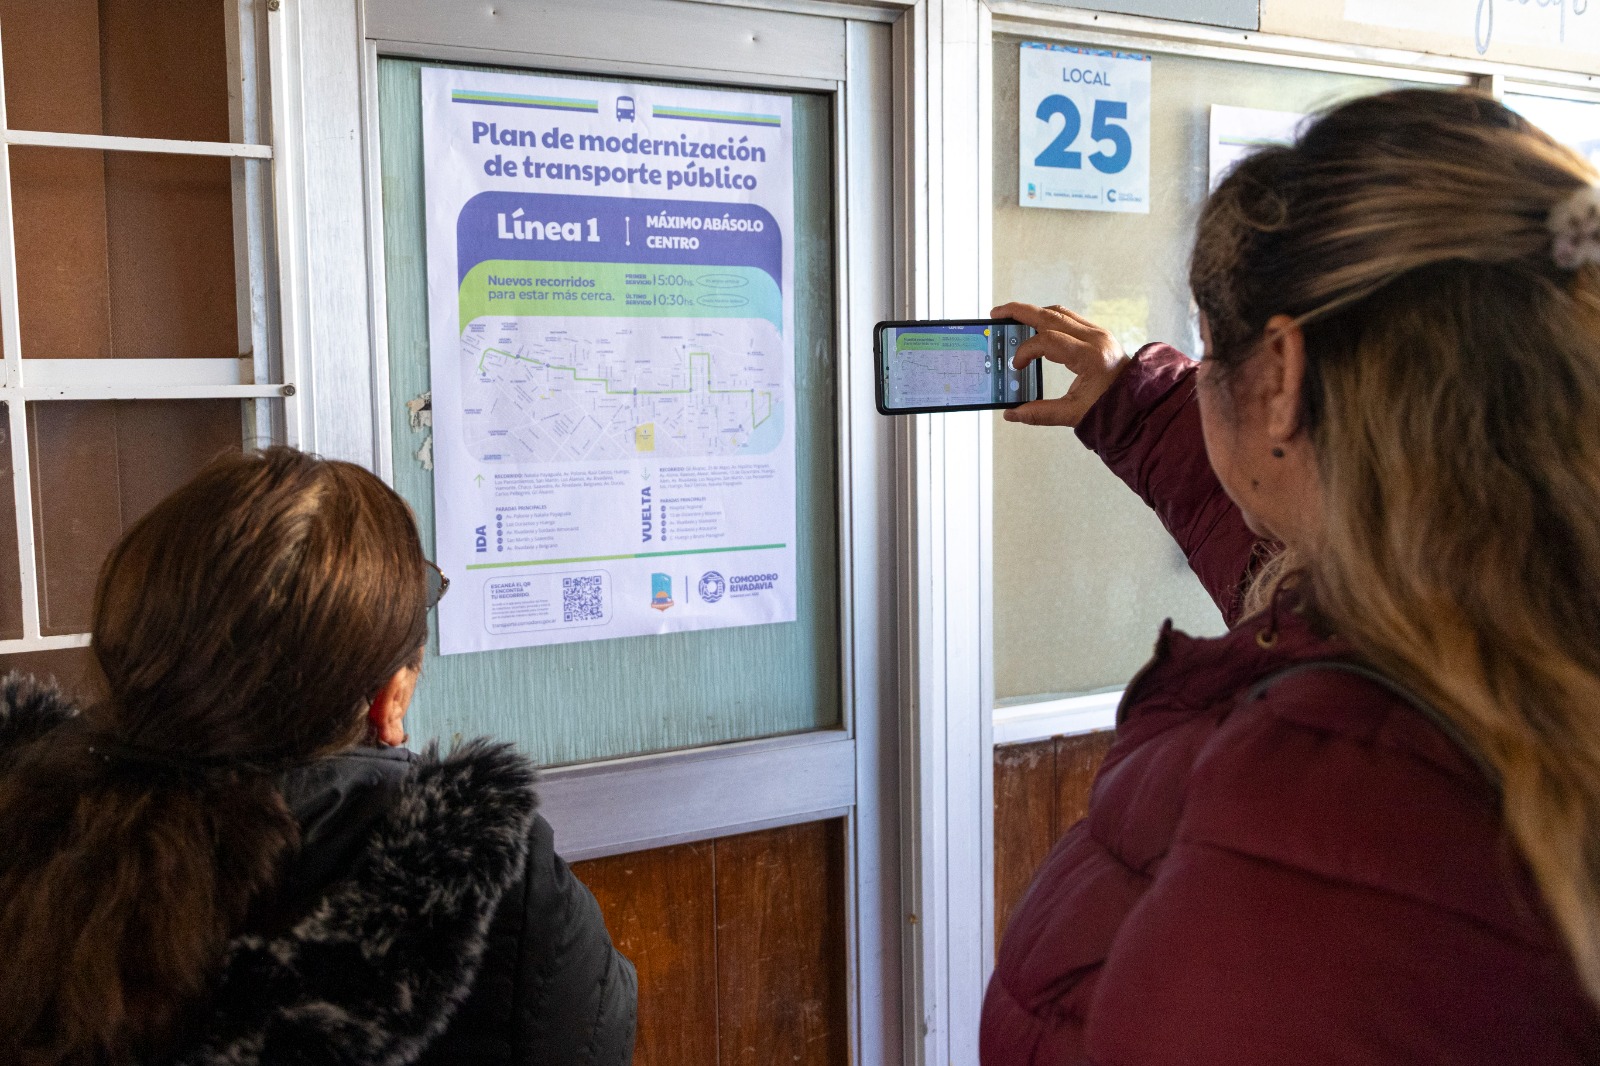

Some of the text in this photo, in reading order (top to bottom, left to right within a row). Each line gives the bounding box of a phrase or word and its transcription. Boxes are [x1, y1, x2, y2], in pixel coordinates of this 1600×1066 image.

[1063, 67, 1111, 86] LOCAL
[472, 121, 766, 163] Plan de modernización
[1034, 94, 1132, 174] 25
[484, 154, 757, 190] de transporte público
[498, 207, 600, 242] Línea 1
[646, 210, 764, 232] MÁXIMO ABÁSOLO
[646, 236, 700, 250] CENTRO
[488, 275, 595, 288] Nuevos recorridos
[488, 289, 616, 302] para estar más cerca.
[642, 486, 653, 543] VUELTA
[476, 525, 487, 552] IDA
[729, 573, 778, 584] COMODORO
[730, 582, 773, 592] RIVADAVIA
